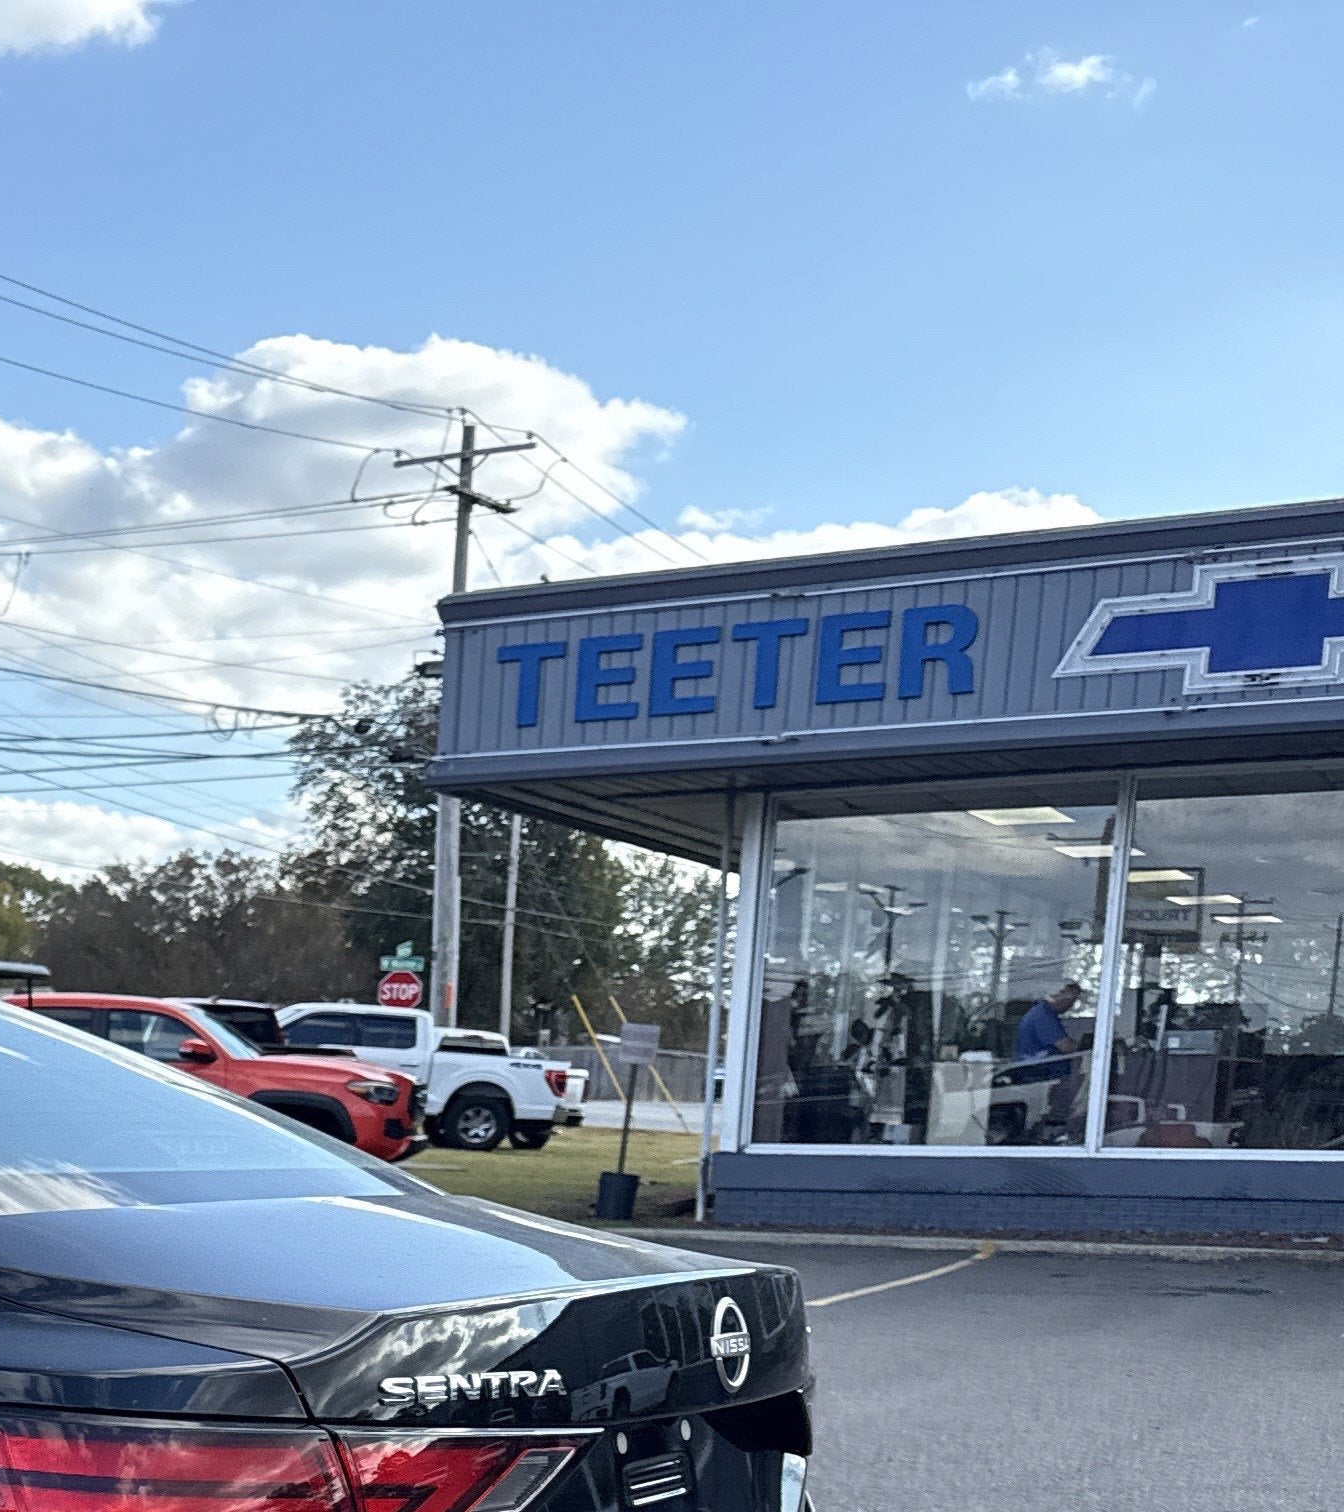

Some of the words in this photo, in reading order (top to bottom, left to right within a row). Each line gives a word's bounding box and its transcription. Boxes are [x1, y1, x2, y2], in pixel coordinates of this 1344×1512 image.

[496, 603, 980, 729] TEETER
[380, 982, 419, 1001] STOP
[379, 1369, 567, 1404] SENTRA
